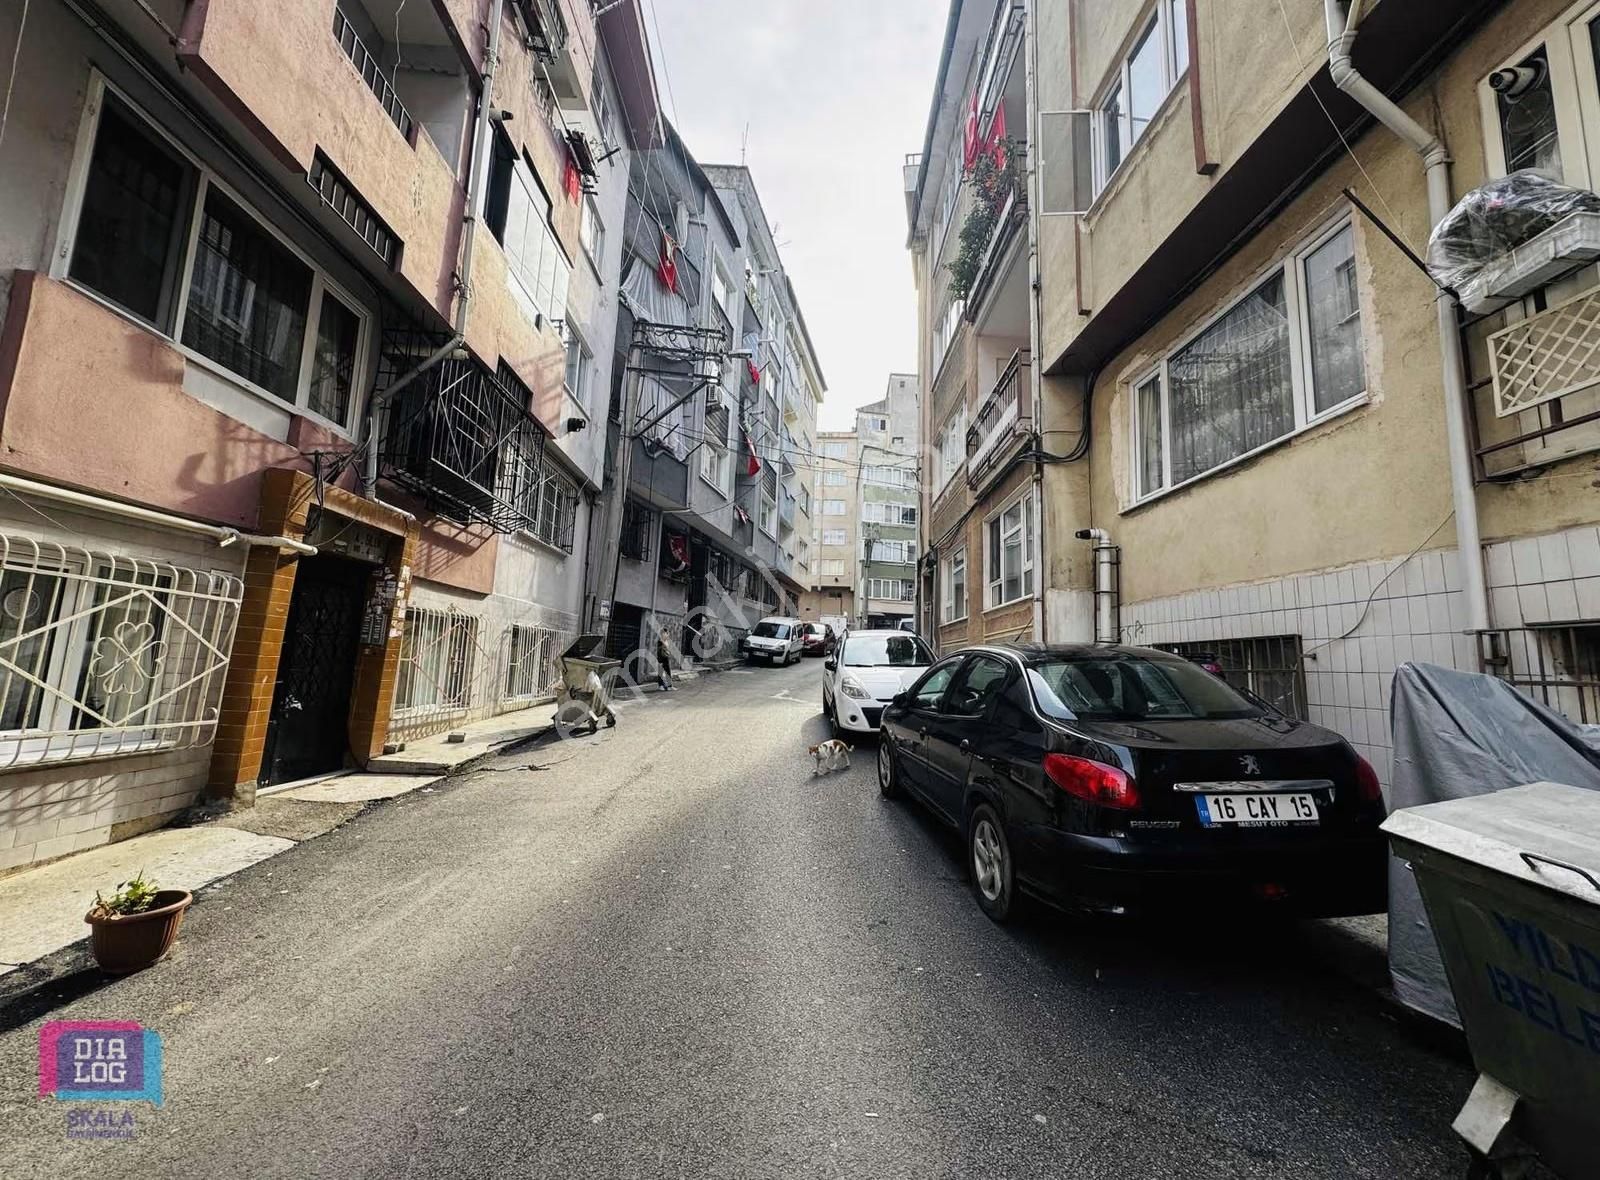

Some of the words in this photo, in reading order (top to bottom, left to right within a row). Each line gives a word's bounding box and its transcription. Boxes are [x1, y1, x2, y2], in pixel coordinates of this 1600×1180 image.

[1213, 797, 1237, 819] 16
[1245, 796, 1280, 819] CAY
[1289, 796, 1313, 818] 15
[1129, 820, 1182, 829] PEUGEOT
